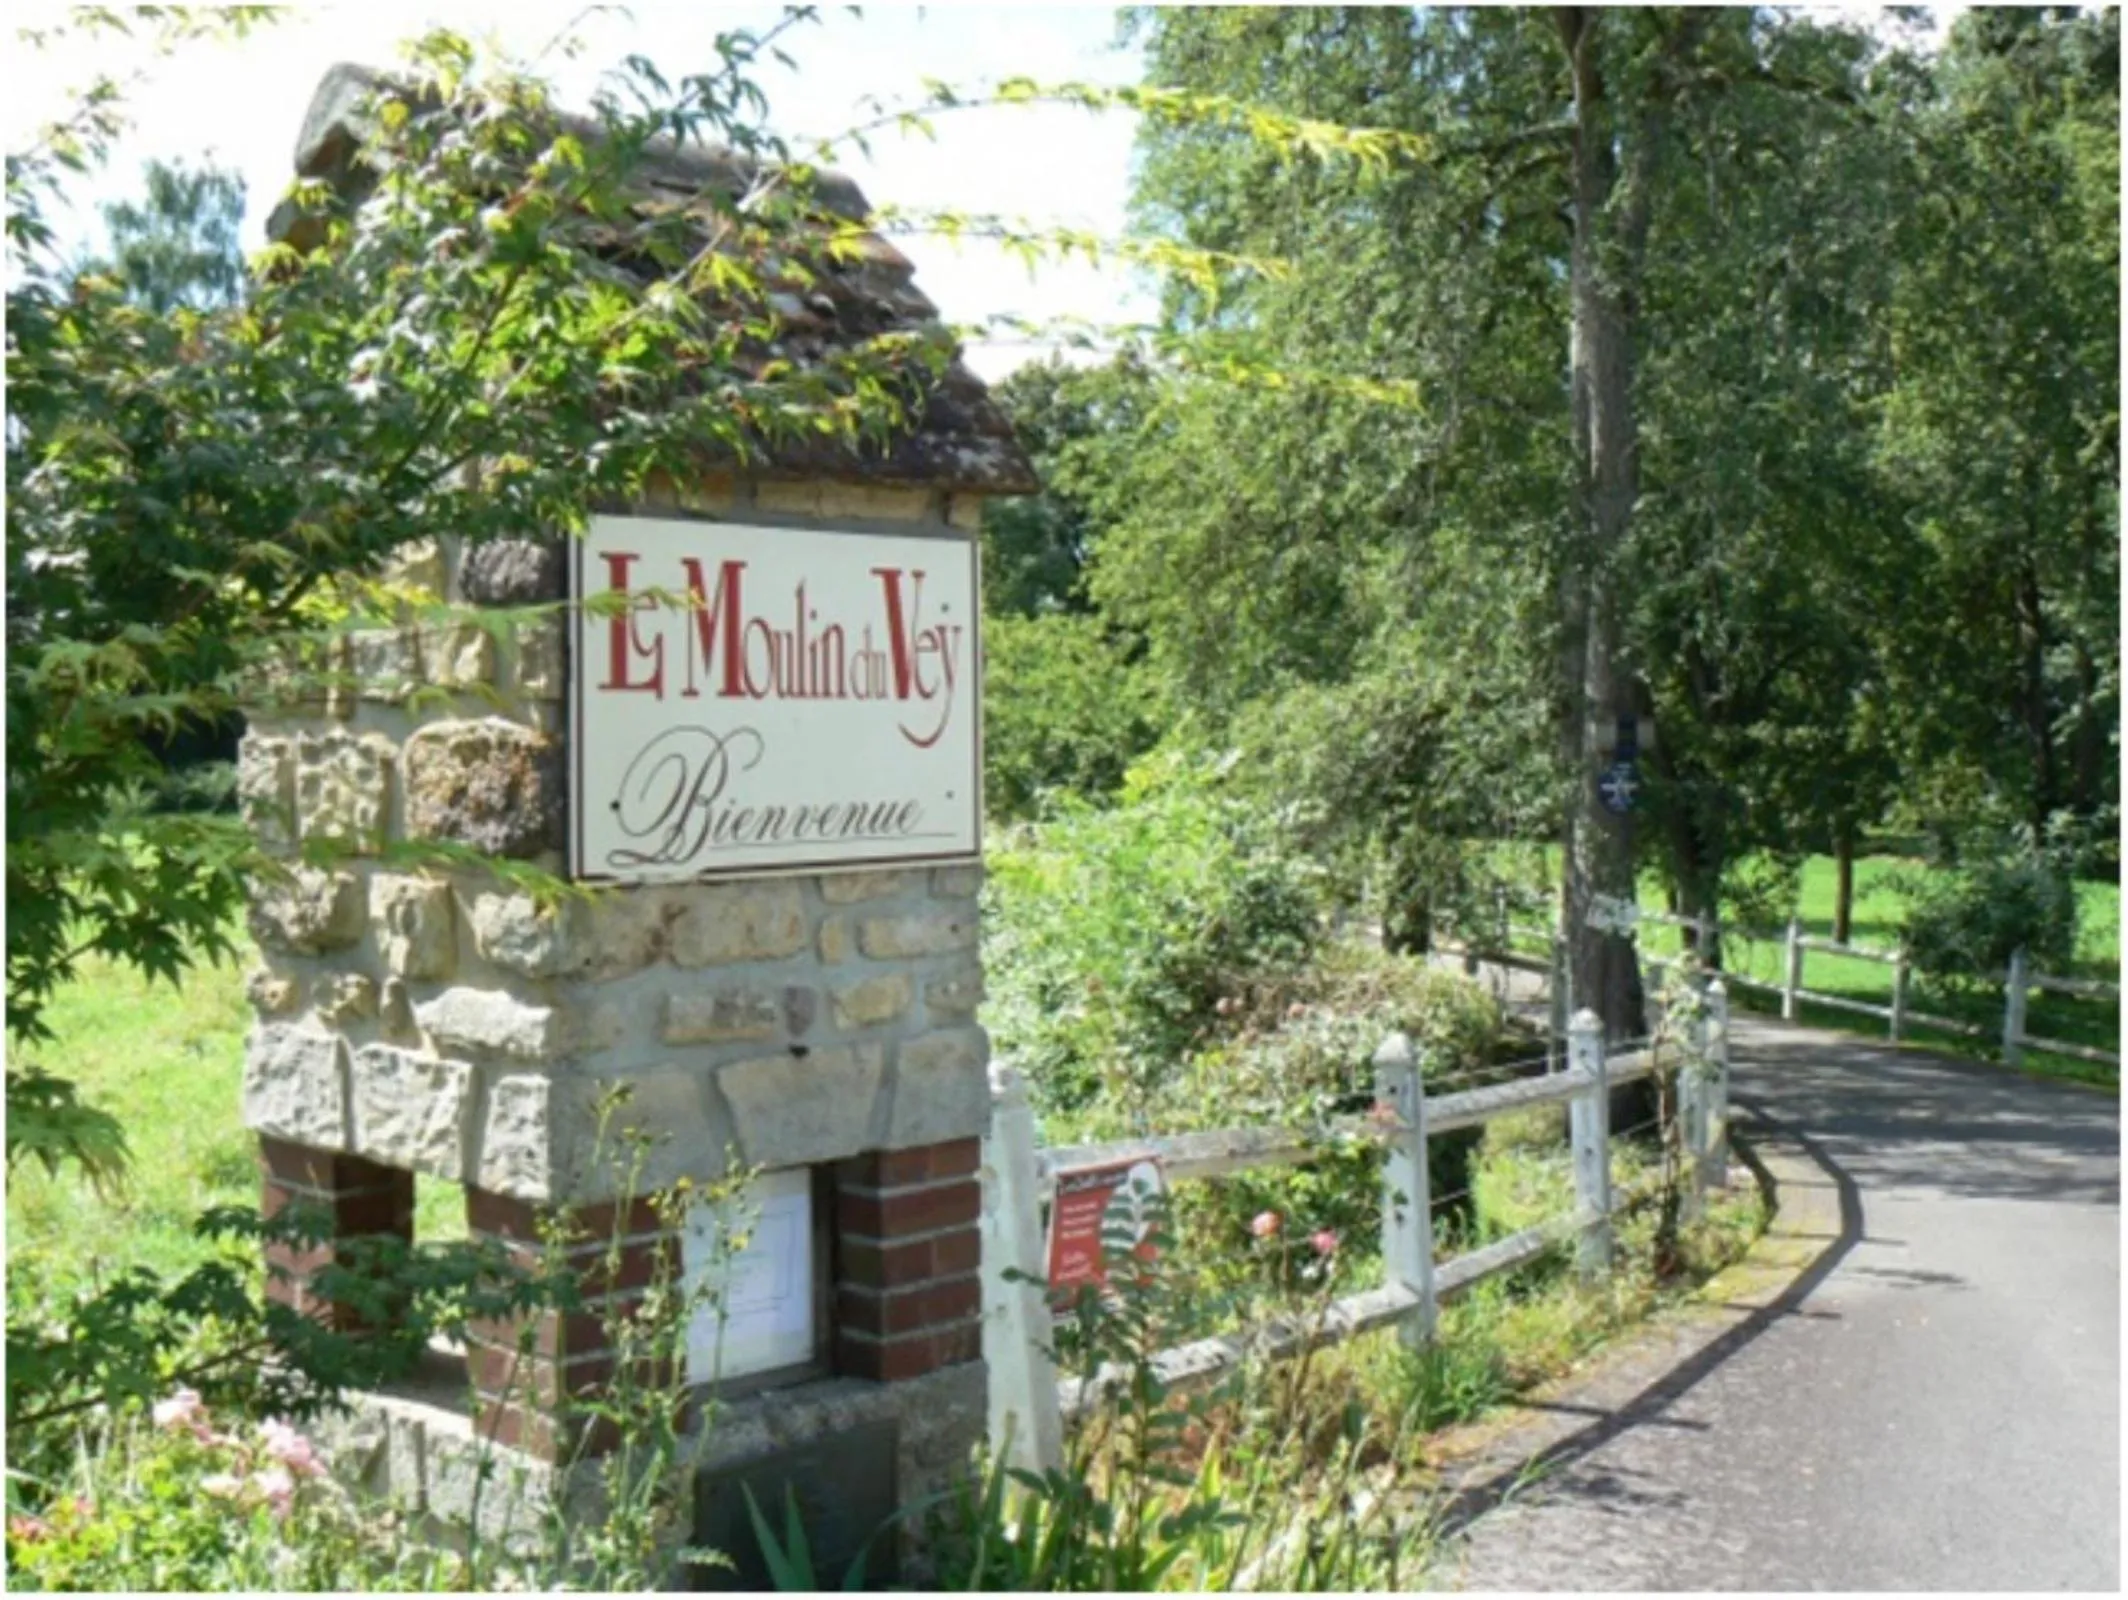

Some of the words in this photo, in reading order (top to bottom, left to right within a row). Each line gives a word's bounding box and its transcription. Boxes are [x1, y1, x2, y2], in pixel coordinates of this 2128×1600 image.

[598, 551, 664, 701] Le
[681, 557, 846, 699] Moulin
[850, 623, 888, 699] du
[606, 725, 957, 867] Bienvenue
